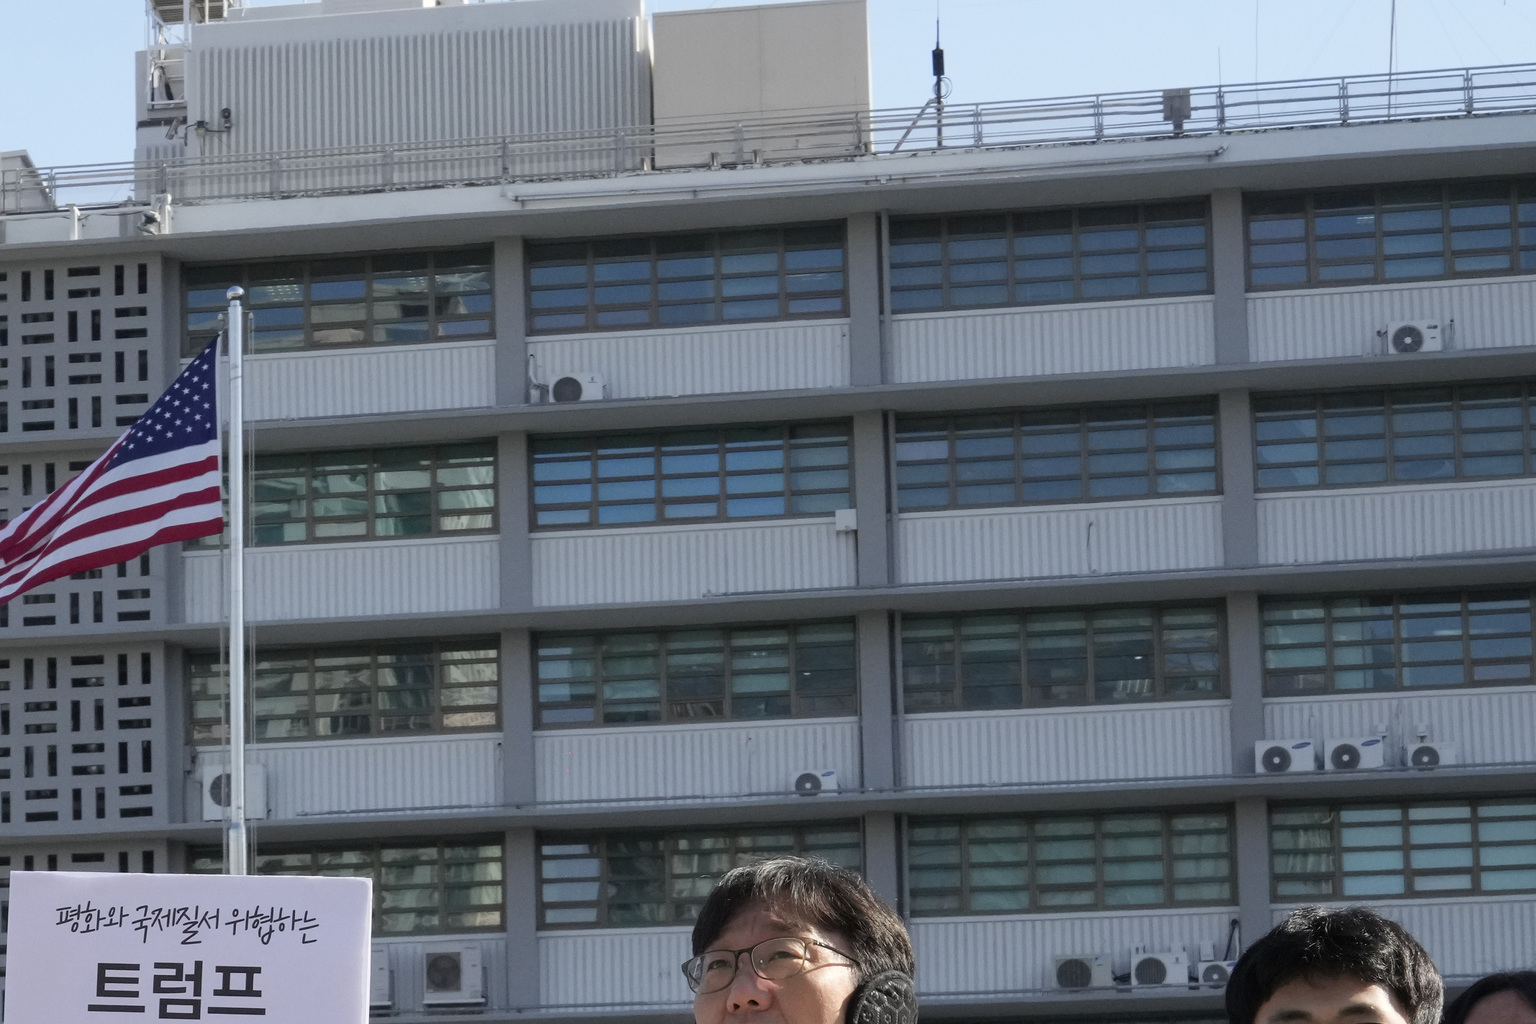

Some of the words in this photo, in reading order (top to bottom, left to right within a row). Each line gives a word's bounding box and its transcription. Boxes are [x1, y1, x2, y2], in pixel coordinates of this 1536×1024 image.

[55, 900, 130, 934] 평화와
[131, 904, 220, 946] 국제질서
[224, 905, 321, 946] 위협하는
[87, 960, 267, 1020] 트럼프
